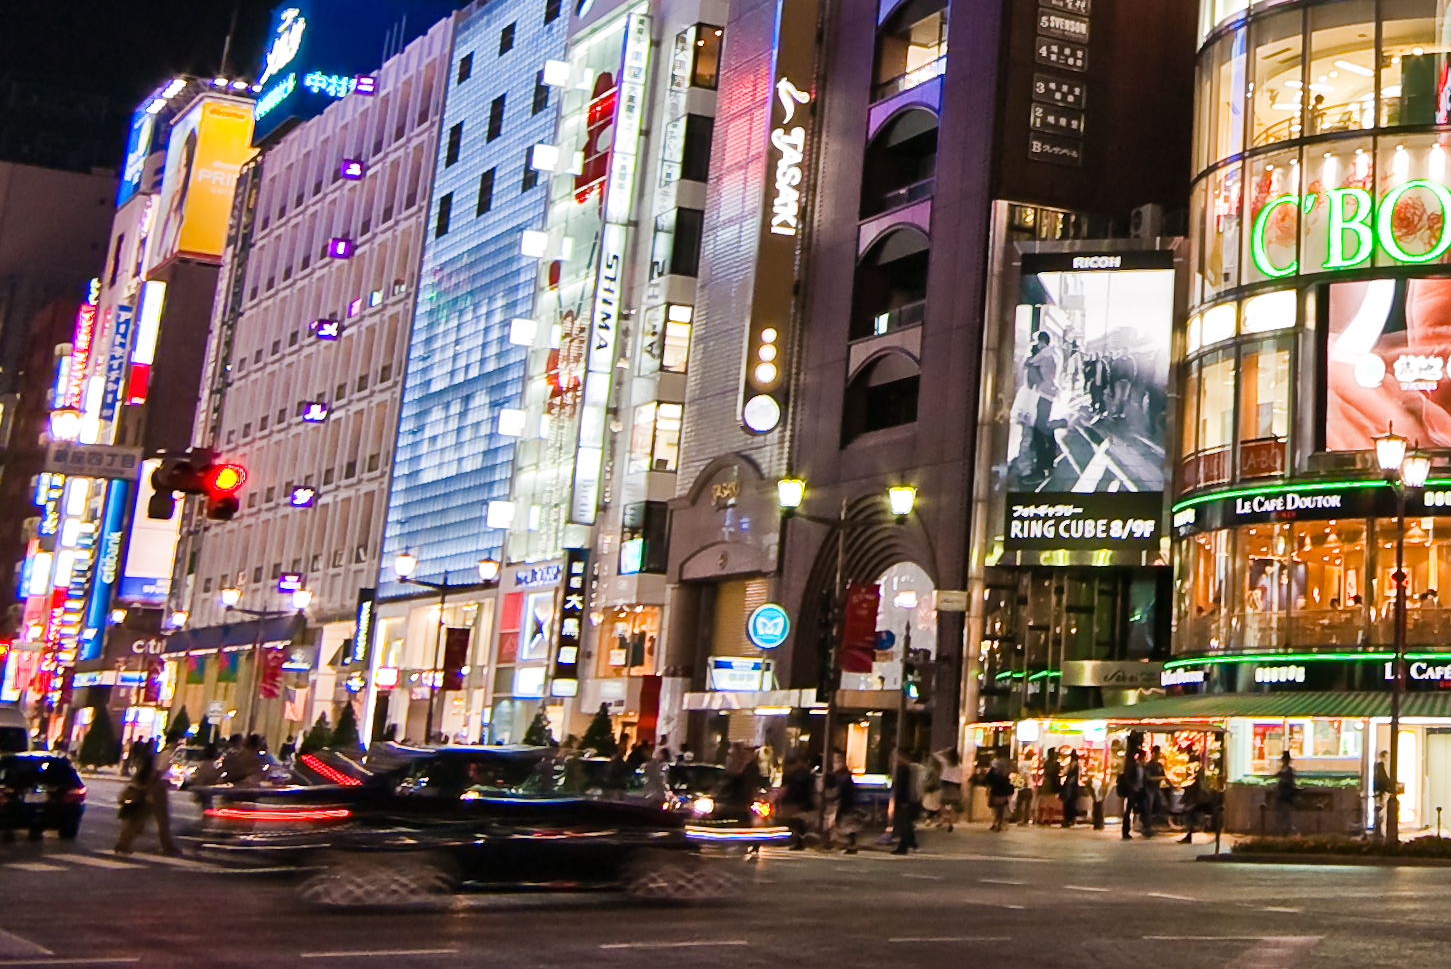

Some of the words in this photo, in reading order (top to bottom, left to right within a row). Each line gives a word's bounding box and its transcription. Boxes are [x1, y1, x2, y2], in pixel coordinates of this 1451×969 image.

[1040, 16, 1049, 27] 5
[1039, 45, 1048, 57] 4
[1036, 82, 1046, 93] 3
[1032, 140, 1042, 152] B
[771, 126, 806, 236] TASAKI
[1073, 256, 1121, 269] RICOH
[595, 253, 619, 350] SHIMA
[1286, 493, 1341, 510] DOUTOR
[1010, 519, 1055, 539] RING
[1058, 519, 1108, 539] CUBE
[1109, 518, 1155, 540] 8/9F
